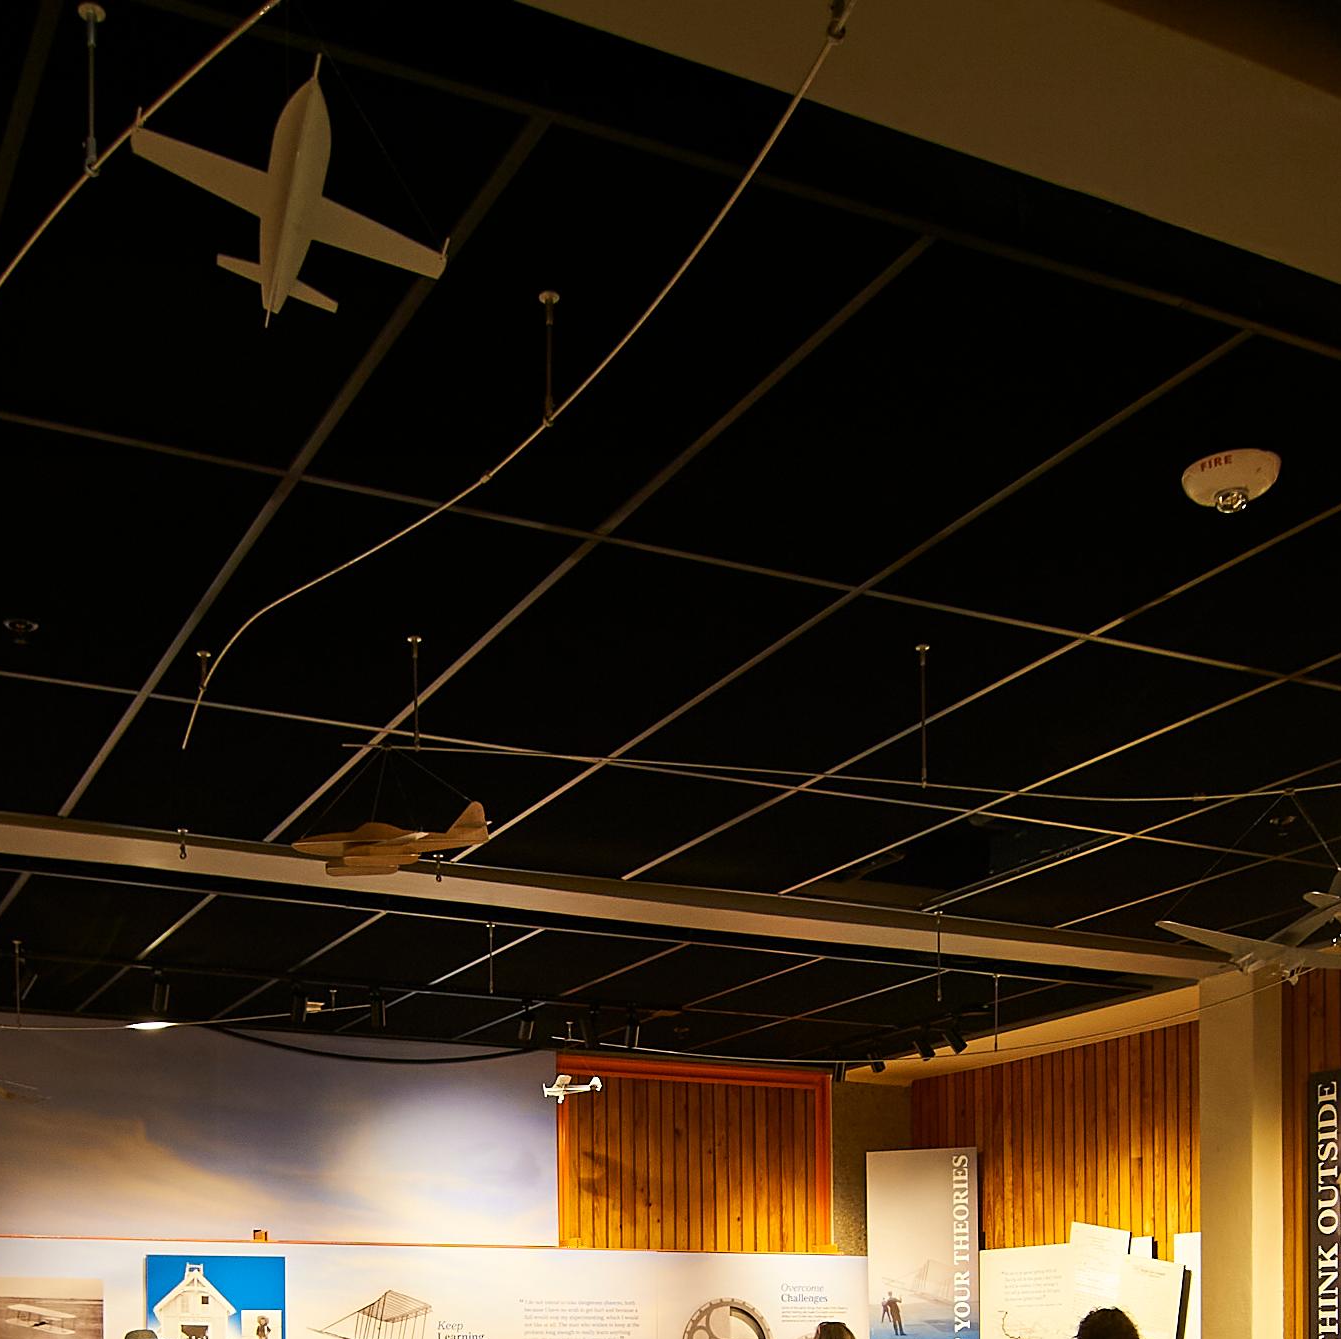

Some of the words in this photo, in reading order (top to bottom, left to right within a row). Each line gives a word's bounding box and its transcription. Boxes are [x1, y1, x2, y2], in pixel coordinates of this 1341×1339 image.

[1200, 454, 1233, 472] FIRE
[1317, 1081, 1339, 1235] OUTSIDE
[953, 1154, 970, 1265] THEORIES
[781, 1283, 824, 1292] Overcome
[781, 1294, 828, 1304] Challenges
[954, 1272, 971, 1333] YOUR
[437, 1321, 463, 1331] Keep
